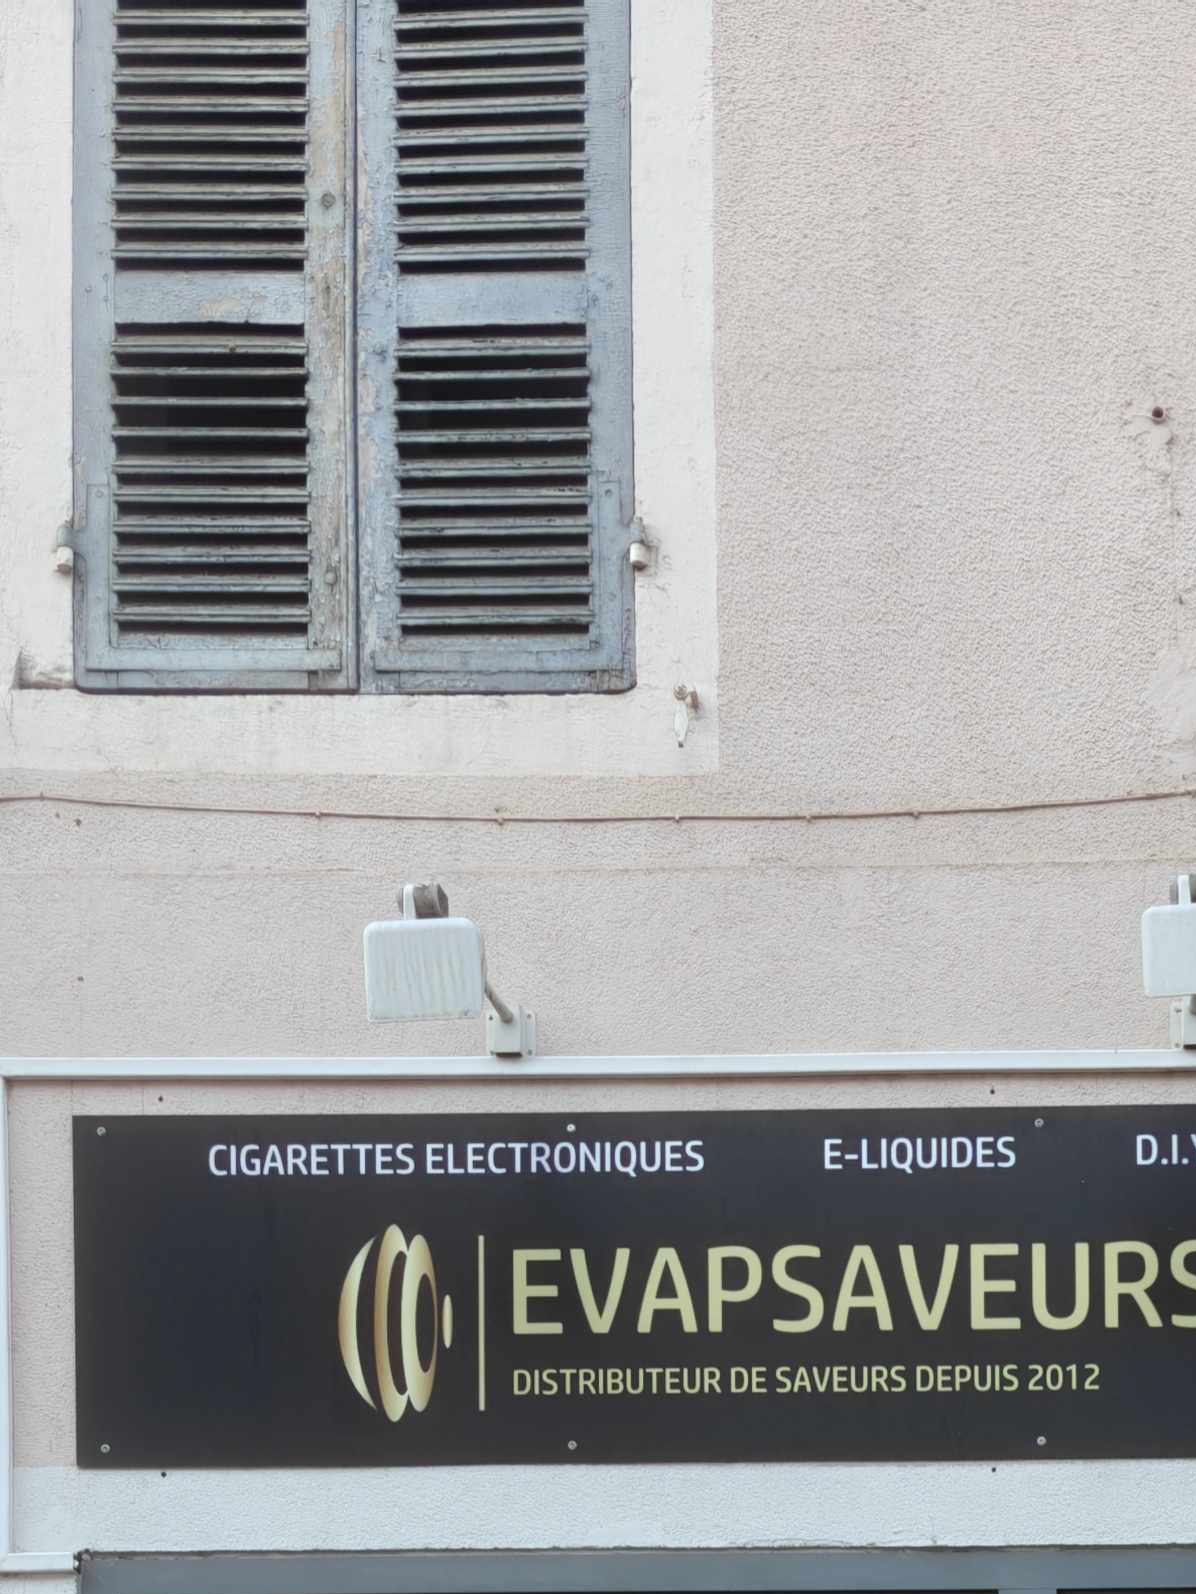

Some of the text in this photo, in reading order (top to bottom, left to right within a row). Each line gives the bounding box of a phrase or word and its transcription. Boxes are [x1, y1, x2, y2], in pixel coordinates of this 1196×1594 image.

[208, 1139, 705, 1177] CIGARETTES ELECTRONIQUES
[824, 1135, 1016, 1173] E-LIQUIDES
[513, 1363, 1100, 1396] DISTRIBUTEUR DE SAVEURS DEPUIS 2012
